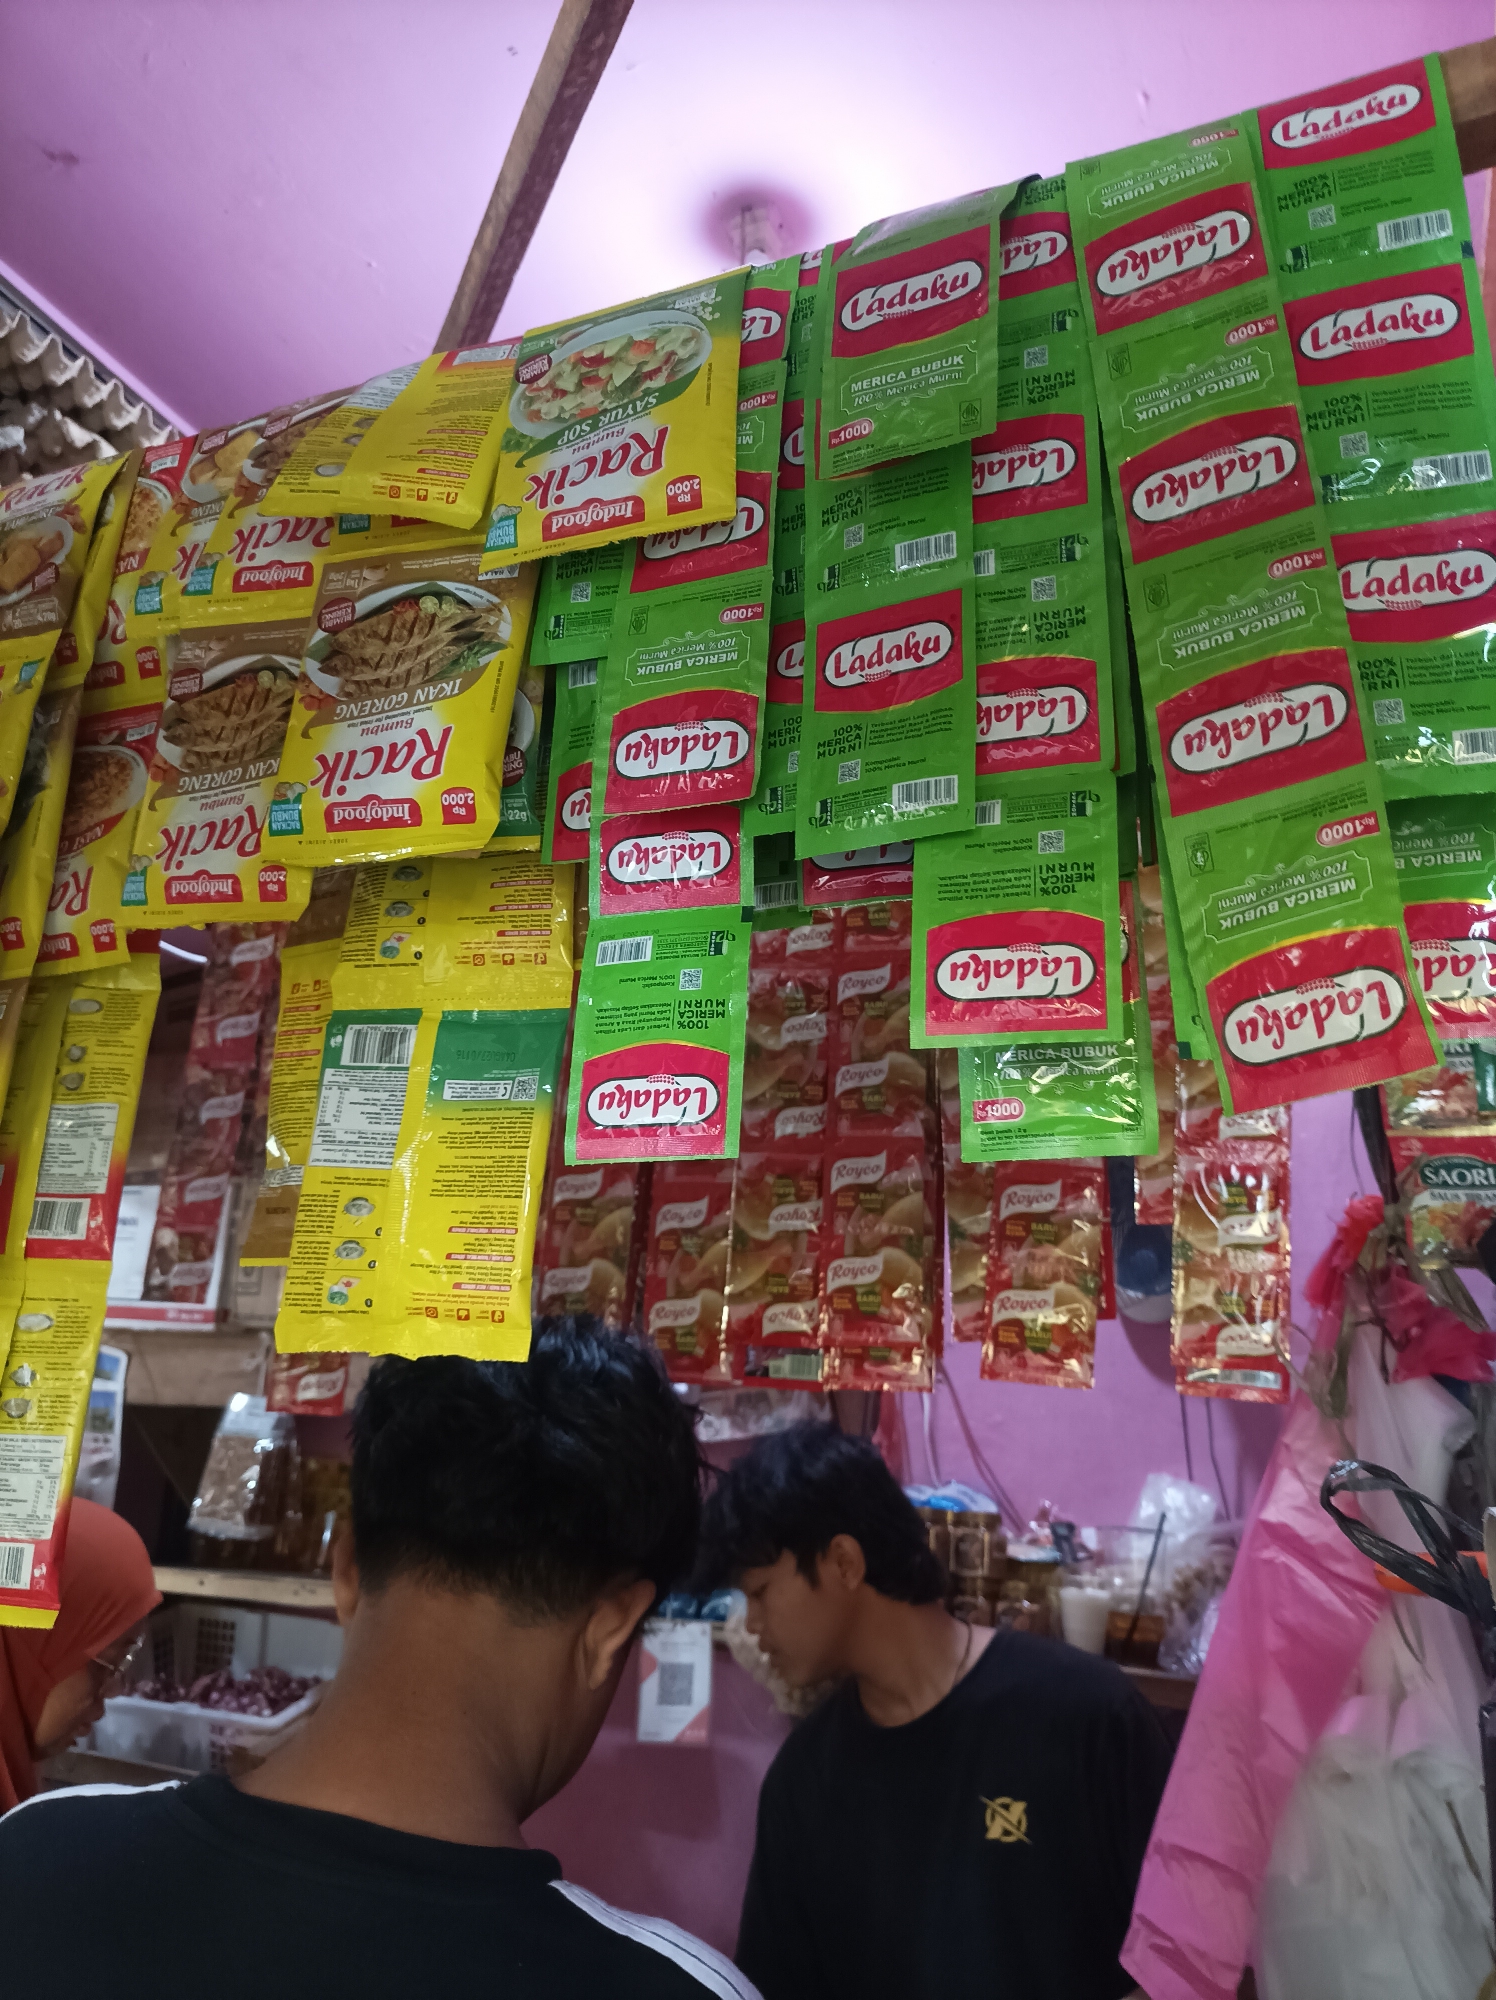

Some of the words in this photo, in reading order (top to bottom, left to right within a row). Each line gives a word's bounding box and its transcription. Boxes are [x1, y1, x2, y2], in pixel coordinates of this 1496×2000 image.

[1281, 93, 1407, 142] Ladaku
[1158, 159, 1219, 187] MERICA
[1100, 178, 1135, 197] Murni
[1100, 182, 1156, 210] BUBUK
[1107, 218, 1240, 284] Ladaku
[851, 272, 969, 324] Ladaku
[1310, 302, 1445, 352] Ladaku
[1218, 353, 1253, 373] 100%
[851, 371, 907, 393] MERICA
[911, 354, 964, 376] BUBUK
[1025, 369, 1075, 384] MURNI
[1172, 368, 1216, 392] Merica
[1196, 368, 1260, 397] MERICA
[853, 391, 883, 407] 100%
[886, 380, 925, 397] Merica
[929, 370, 962, 386] Murni
[1026, 377, 1075, 394] MERICA
[1026, 390, 1059, 405] 100%
[1134, 387, 1170, 407] Murni
[1324, 393, 1362, 408] 100%
[599, 392, 659, 425] SAYUR
[1135, 394, 1193, 422] BUBUK
[1305, 403, 1364, 422] MERICA
[557, 420, 592, 446] SOP
[1306, 415, 1366, 432] MURNI
[572, 427, 625, 454] Bumbu
[832, 422, 870, 445] Rp1000
[523, 425, 669, 510] Racik
[1143, 444, 1285, 509] Ladaku
[667, 479, 700, 495] 2.000
[835, 488, 862, 503] 100%
[677, 494, 691, 503] Rp
[822, 497, 862, 518] MERICA
[552, 500, 634, 532] Indofood
[822, 505, 863, 527] MURNI
[227, 516, 335, 564] Racik
[239, 564, 305, 585] Indofood
[556, 566, 593, 580] MURNI
[557, 558, 593, 572] MERICA
[1341, 560, 1485, 600] Ladaku
[1262, 589, 1299, 610] 100%
[321, 606, 352, 621] KERING
[321, 614, 352, 628] BUMBU
[723, 606, 762, 621] Rp1000
[1033, 605, 1085, 620] MURNI
[1212, 605, 1259, 627] Merica
[1238, 605, 1307, 637] MERICA
[1034, 616, 1086, 632] MERICA
[1172, 621, 1210, 641] Murni
[709, 637, 736, 649] 100%
[1035, 629, 1070, 642] 100%
[1173, 630, 1235, 660] BUBUK
[136, 650, 158, 662] 2.000
[639, 649, 668, 660] Murni
[671, 642, 705, 655] Merica
[834, 631, 941, 680] Ladaku
[636, 661, 682, 675] BUBUK
[687, 651, 738, 666] MERICA
[414, 679, 462, 704] IKAN
[334, 692, 408, 720] GORENG
[360, 717, 414, 737] Bumbu
[833, 723, 863, 737] 100%
[1182, 693, 1335, 760] Ladaku
[625, 731, 739, 769] Ladaku
[817, 732, 862, 749] MERICA
[817, 741, 861, 759] MURNI
[246, 758, 280, 778] KAN
[310, 724, 454, 799] Racik
[177, 768, 242, 793] GORENG
[199, 793, 245, 812] Bumbu
[442, 793, 474, 805] 2.000
[271, 808, 299, 821] BUMBU
[333, 800, 411, 824] Indofood
[452, 806, 466, 815] Rp
[508, 810, 527, 821] 22g
[272, 820, 300, 830] RACIKAN
[1320, 816, 1375, 841] Rp1000
[155, 805, 268, 871] Racik
[965, 842, 985, 850] Murni
[987, 839, 1011, 847] Merica
[617, 841, 721, 875] Ladaku
[1411, 849, 1482, 868] MERICA
[259, 870, 286, 882] 2.000
[1039, 862, 1095, 874] MURNI
[1309, 860, 1349, 880] 100%
[171, 875, 232, 896] Indofood
[267, 882, 278, 892] Rp
[1040, 873, 1095, 885] MERICA
[1260, 874, 1306, 896] Merica
[1040, 884, 1077, 896] 100%
[1283, 877, 1357, 908] MERICA
[1217, 890, 1258, 911] Murni
[1219, 900, 1279, 931] BUBUK
[91, 923, 115, 934] 2.000
[950, 953, 1081, 991] Ladaku
[842, 975, 885, 990] Royco
[678, 999, 725, 1009] MURNI
[678, 1010, 725, 1019] MERICA
[1235, 979, 1391, 1051] Ladaku
[677, 1020, 709, 1029] 100%
[1061, 1044, 1119, 1059] BUBUK
[841, 1068, 882, 1081] Royco
[597, 1084, 708, 1119] Ladaku
[835, 1163, 880, 1180] Royco
[1006, 1191, 1054, 1209] Royco
[661, 1207, 702, 1222] Royco
[830, 1264, 878, 1282] Royco
[655, 1306, 696, 1319] Royco
[998, 1296, 1047, 1314] Royco
